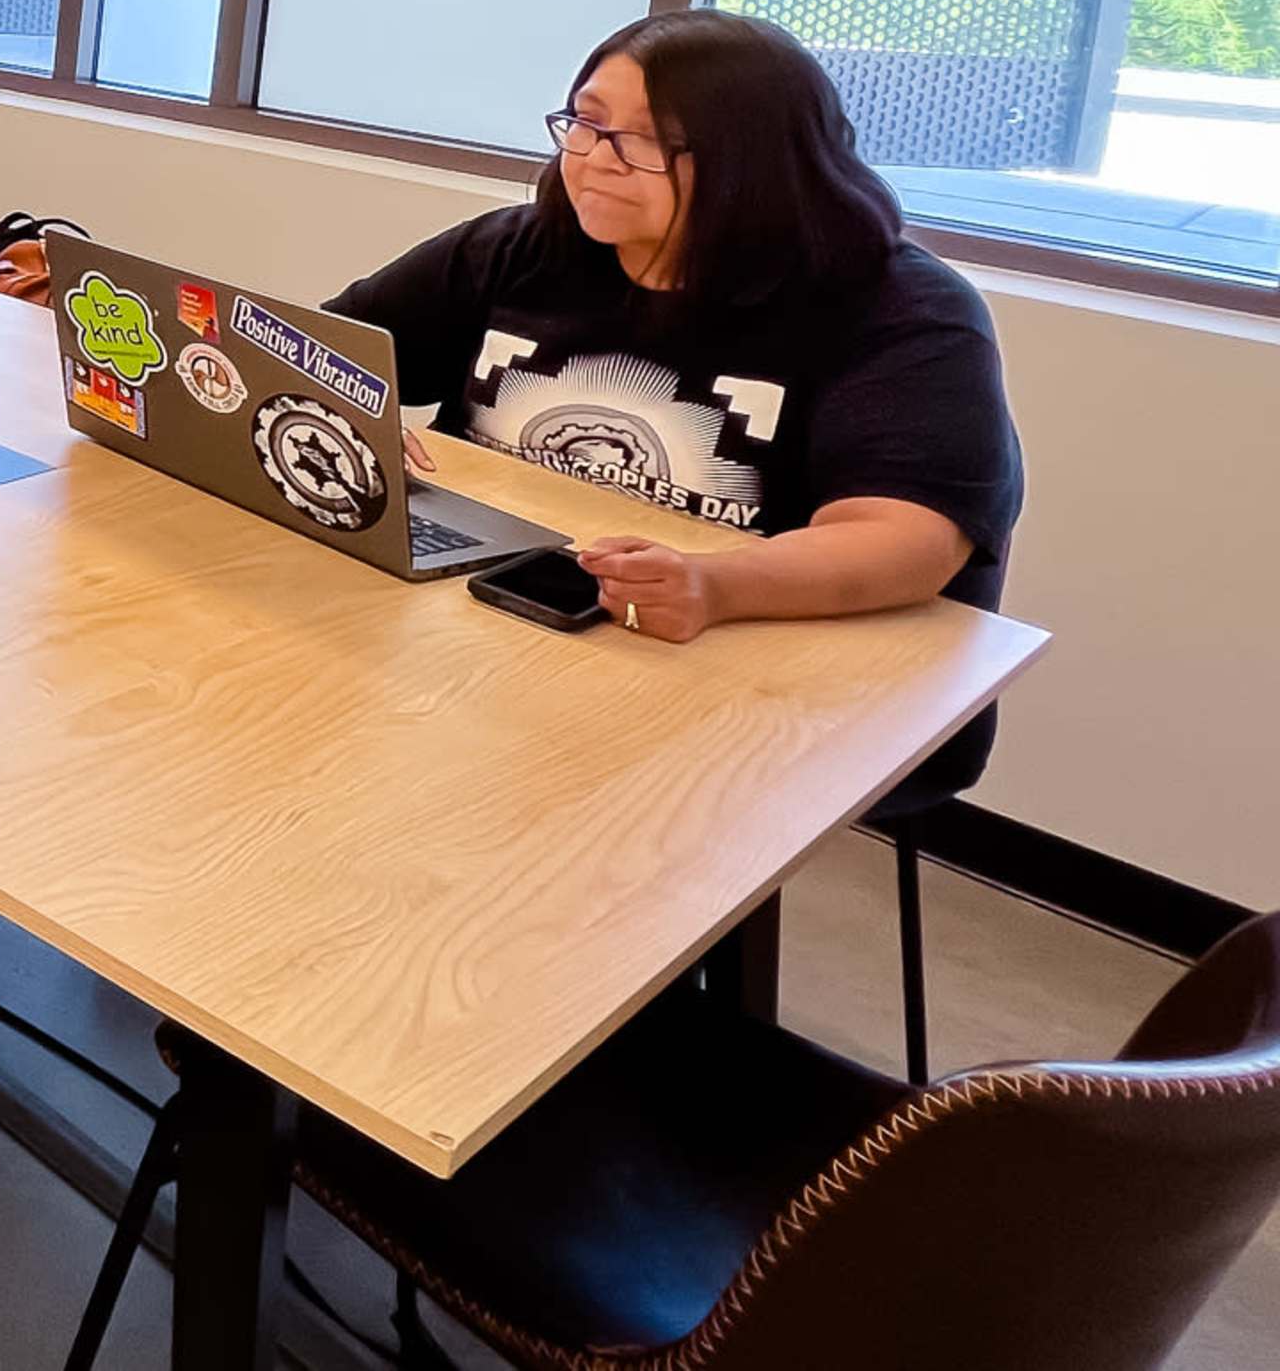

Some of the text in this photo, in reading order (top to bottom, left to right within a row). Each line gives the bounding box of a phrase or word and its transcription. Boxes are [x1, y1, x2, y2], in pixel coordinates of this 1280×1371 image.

[91, 296, 124, 318] be
[88, 319, 144, 345] kind
[236, 301, 299, 362] Positive
[302, 339, 381, 413] Vibration
[700, 494, 761, 527] DAY
